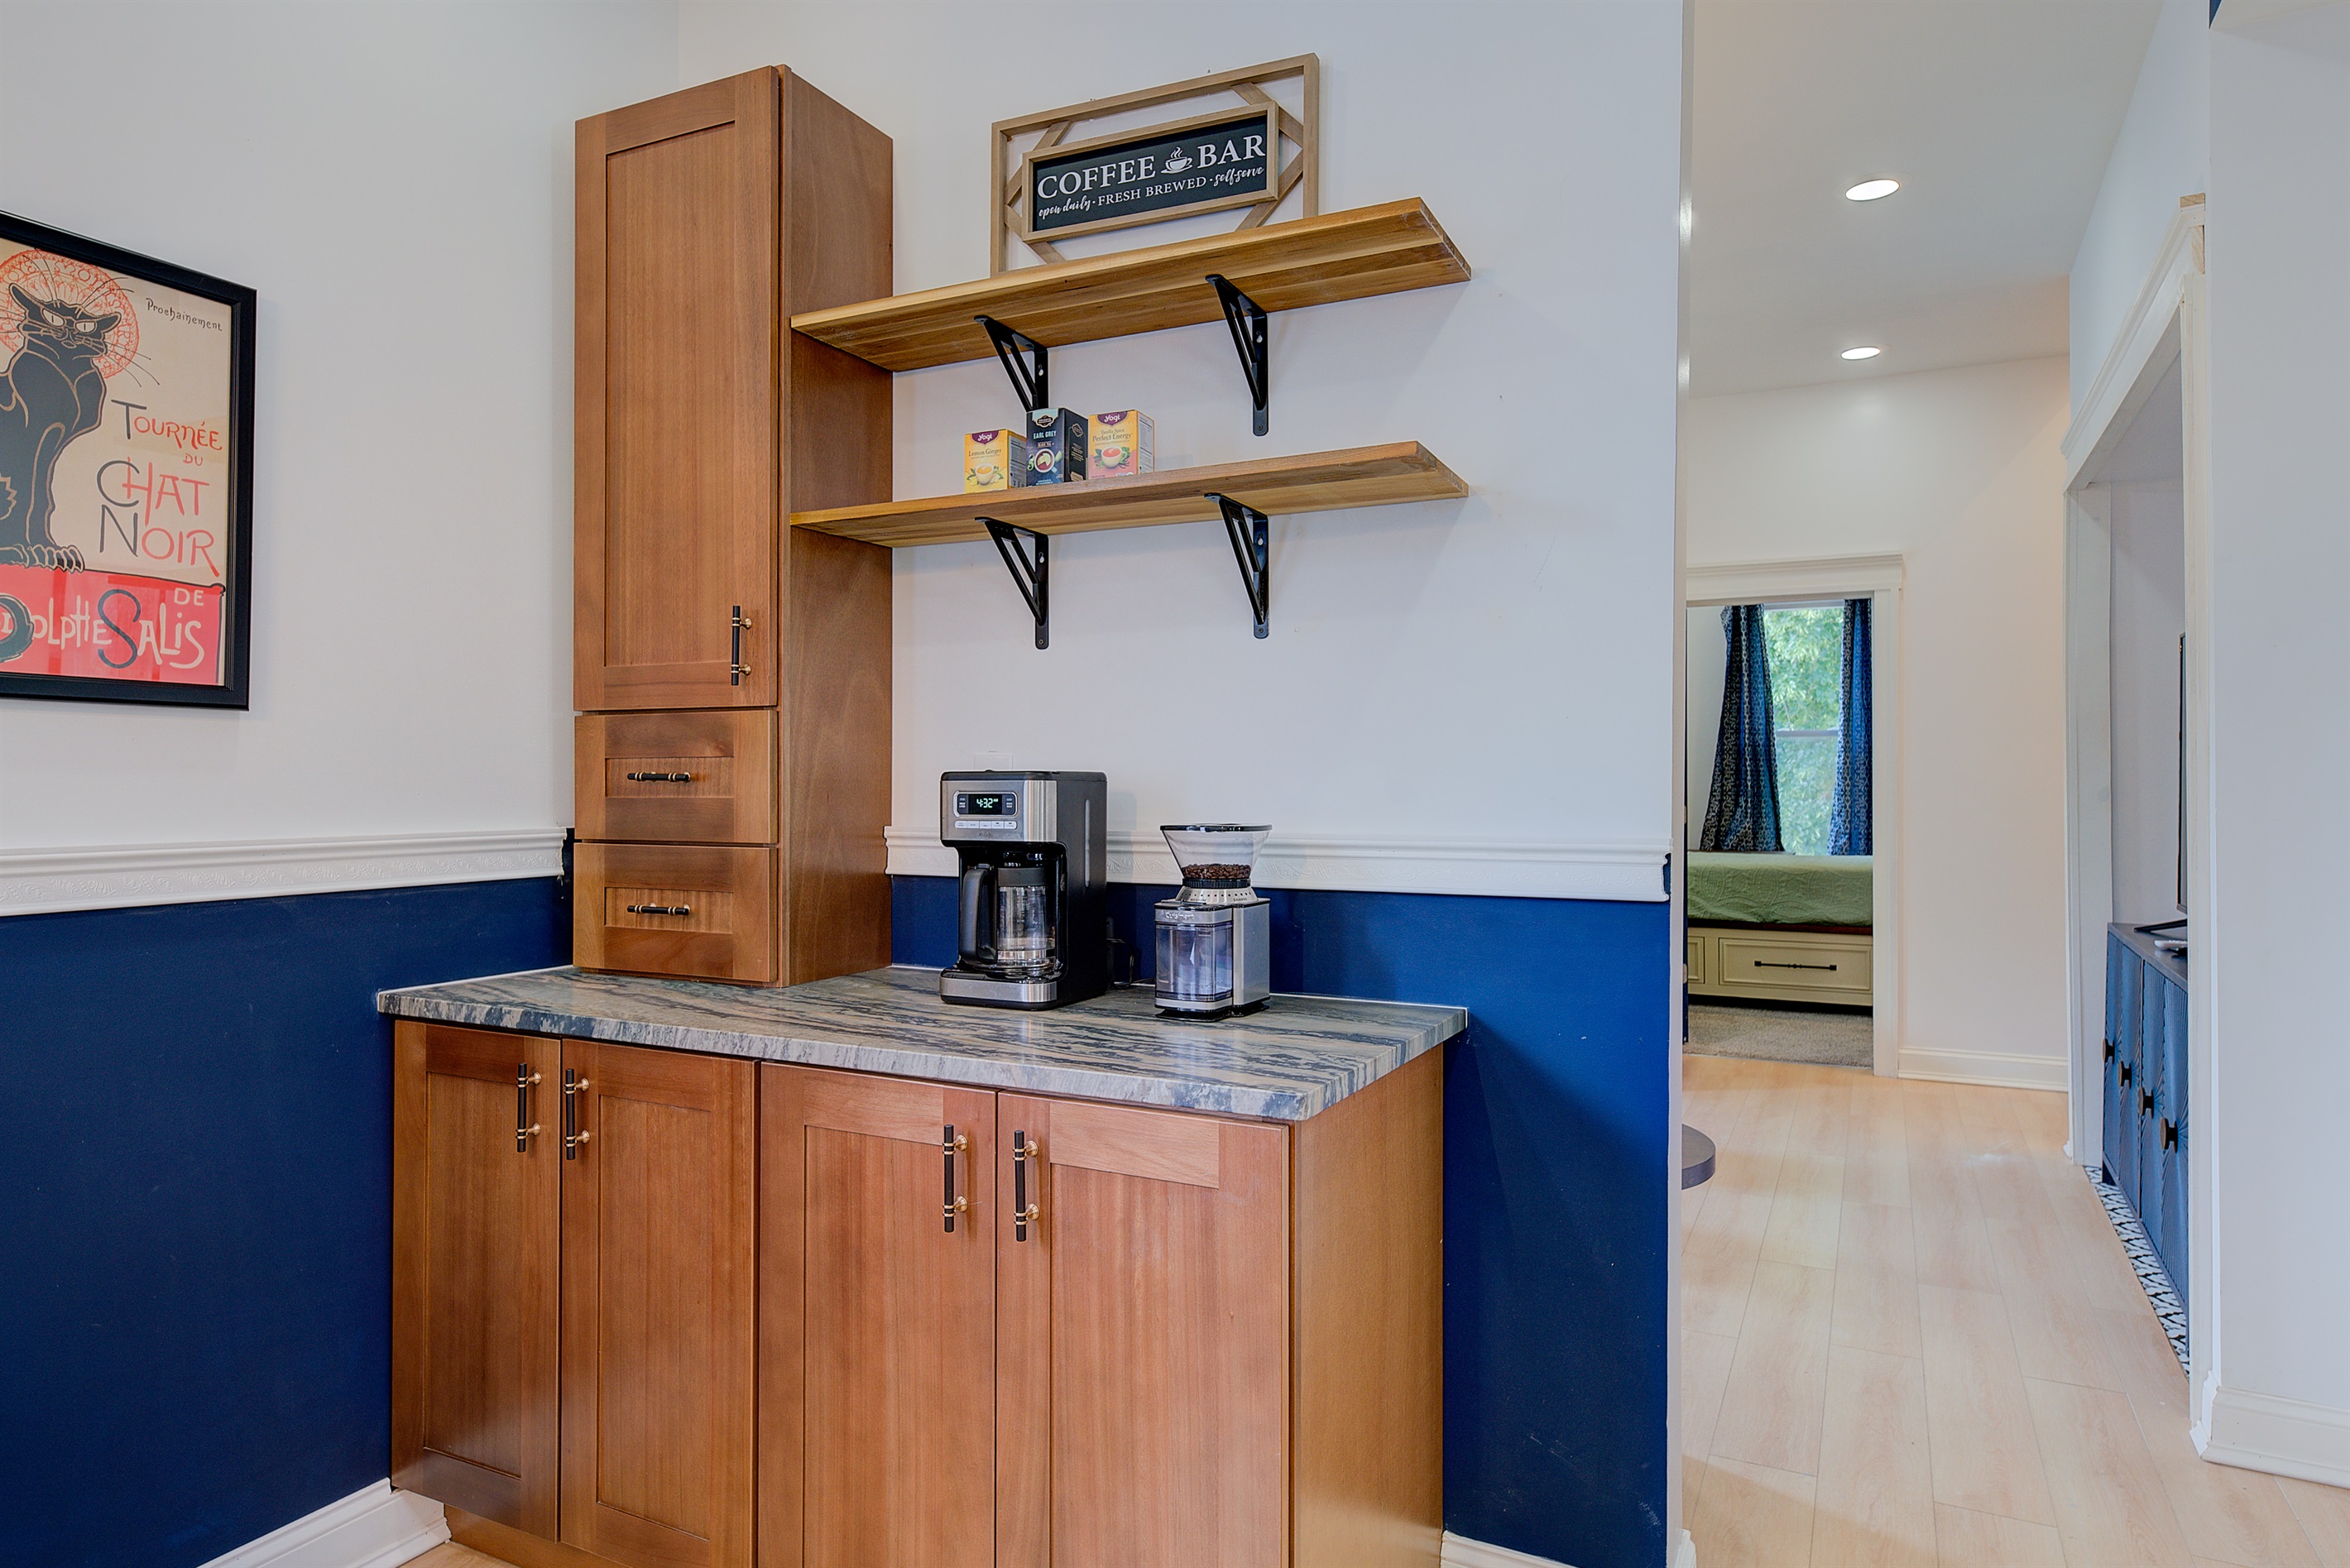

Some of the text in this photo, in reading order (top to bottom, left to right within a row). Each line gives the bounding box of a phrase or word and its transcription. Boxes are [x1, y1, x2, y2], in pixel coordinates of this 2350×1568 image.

[1037, 134, 1266, 199] COFFEE BAR
[1038, 204, 1062, 220] open
[1062, 195, 1091, 212] daily
[1097, 188, 1141, 206] FRESH
[1145, 176, 1206, 197] BREWED
[145, 297, 223, 332] Prochainement
[1033, 431, 1044, 439] EARL
[183, 453, 204, 467] DU
[96, 457, 210, 527] CHAT
[98, 504, 220, 578] NOIR
[174, 587, 204, 606] DE
[976, 798, 993, 808] 4:32
